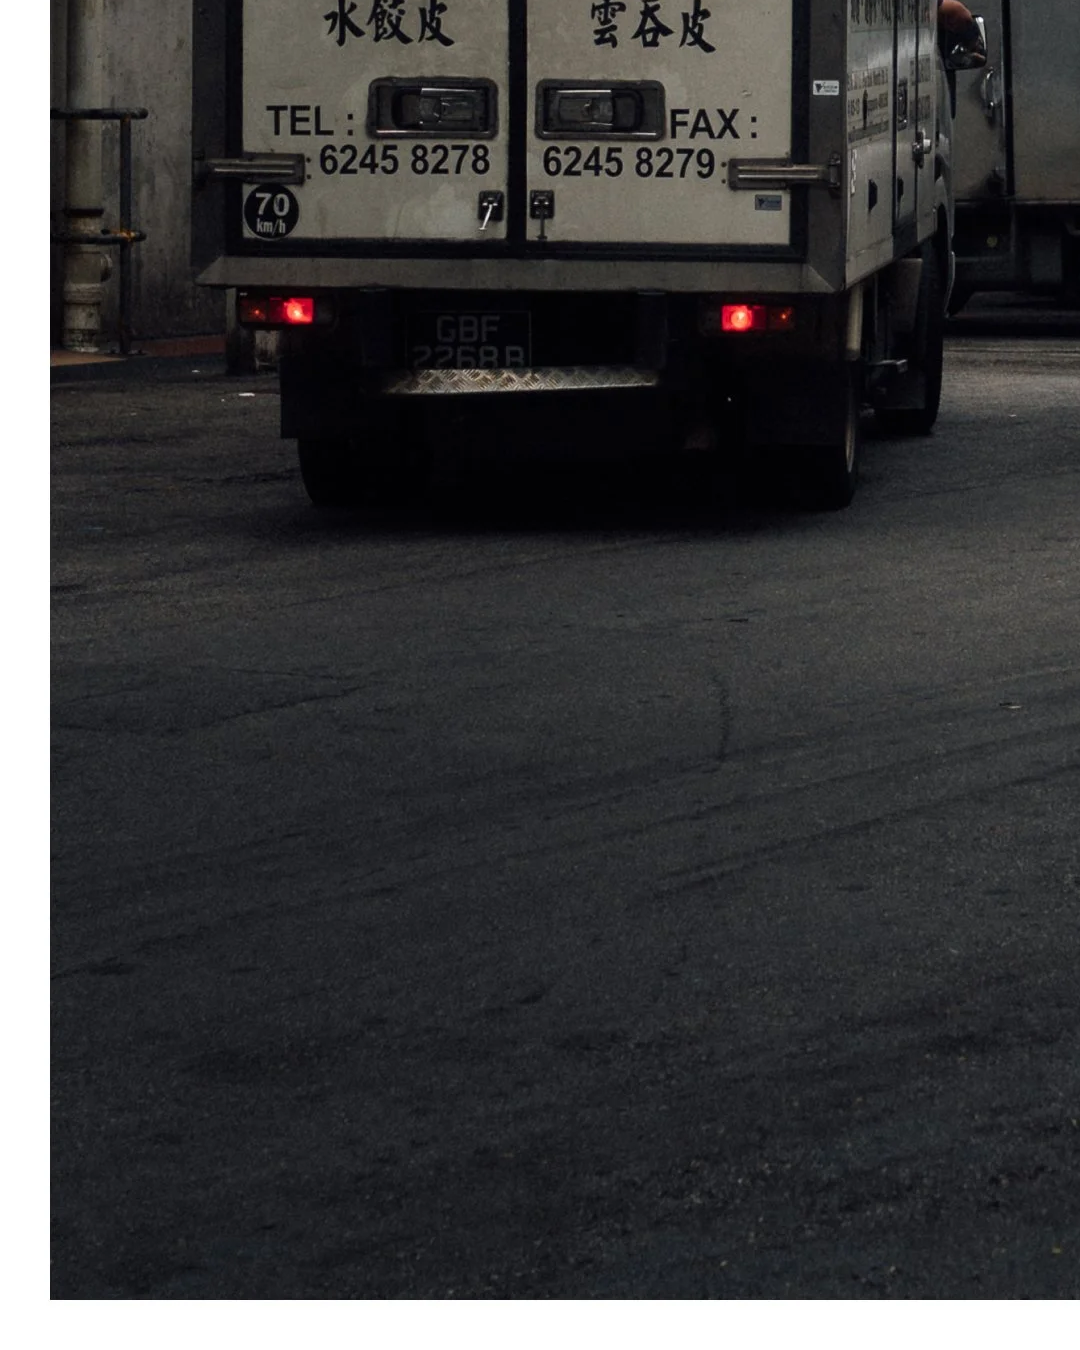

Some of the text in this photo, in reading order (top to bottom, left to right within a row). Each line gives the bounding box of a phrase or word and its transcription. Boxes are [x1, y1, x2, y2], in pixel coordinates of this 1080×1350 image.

[266, 105, 334, 136] TEL
[670, 108, 740, 140] FAX
[319, 144, 490, 175] 6245 8278
[543, 146, 715, 179] 6245 8279
[255, 192, 290, 218] 70
[256, 218, 286, 237] km/h
[435, 313, 501, 344] GBF
